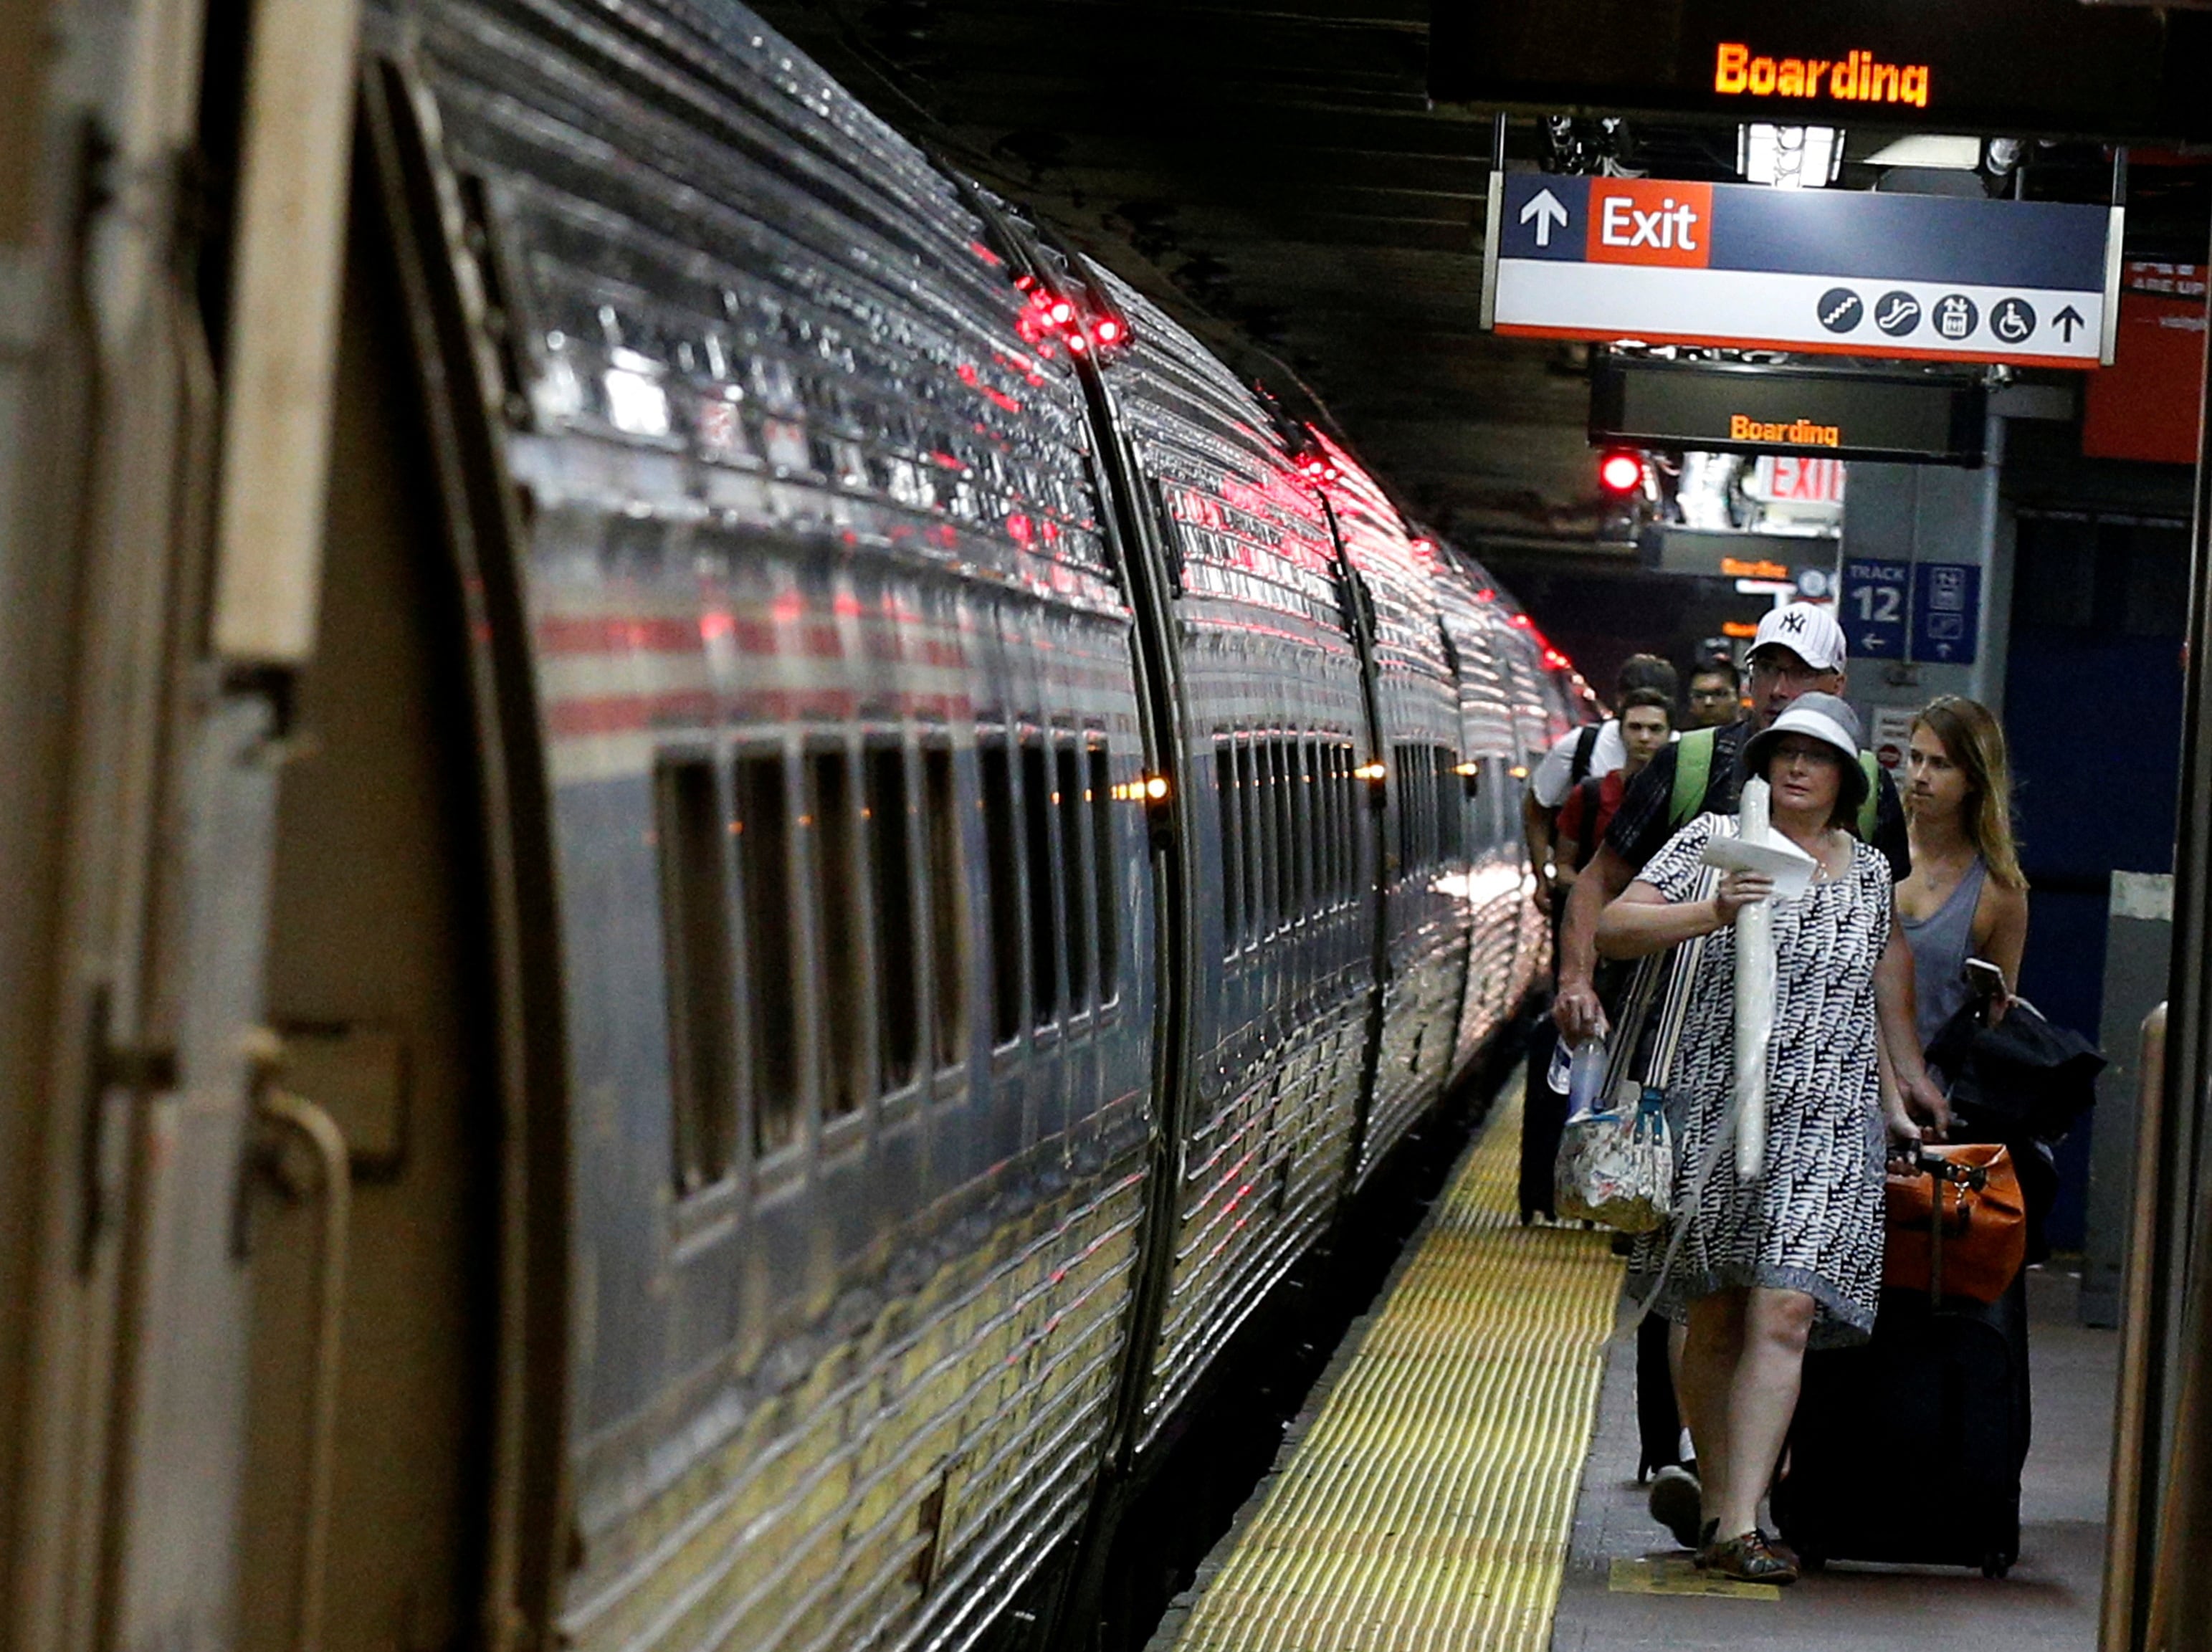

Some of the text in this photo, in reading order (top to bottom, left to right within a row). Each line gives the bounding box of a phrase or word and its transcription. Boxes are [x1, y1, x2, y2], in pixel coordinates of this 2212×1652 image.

[1715, 43, 1927, 108] Boarding
[1602, 196, 1697, 250] Exit
[1731, 415, 1839, 447] Boarding
[1850, 565, 1905, 581] TRACK
[1851, 586, 1900, 621] 12
